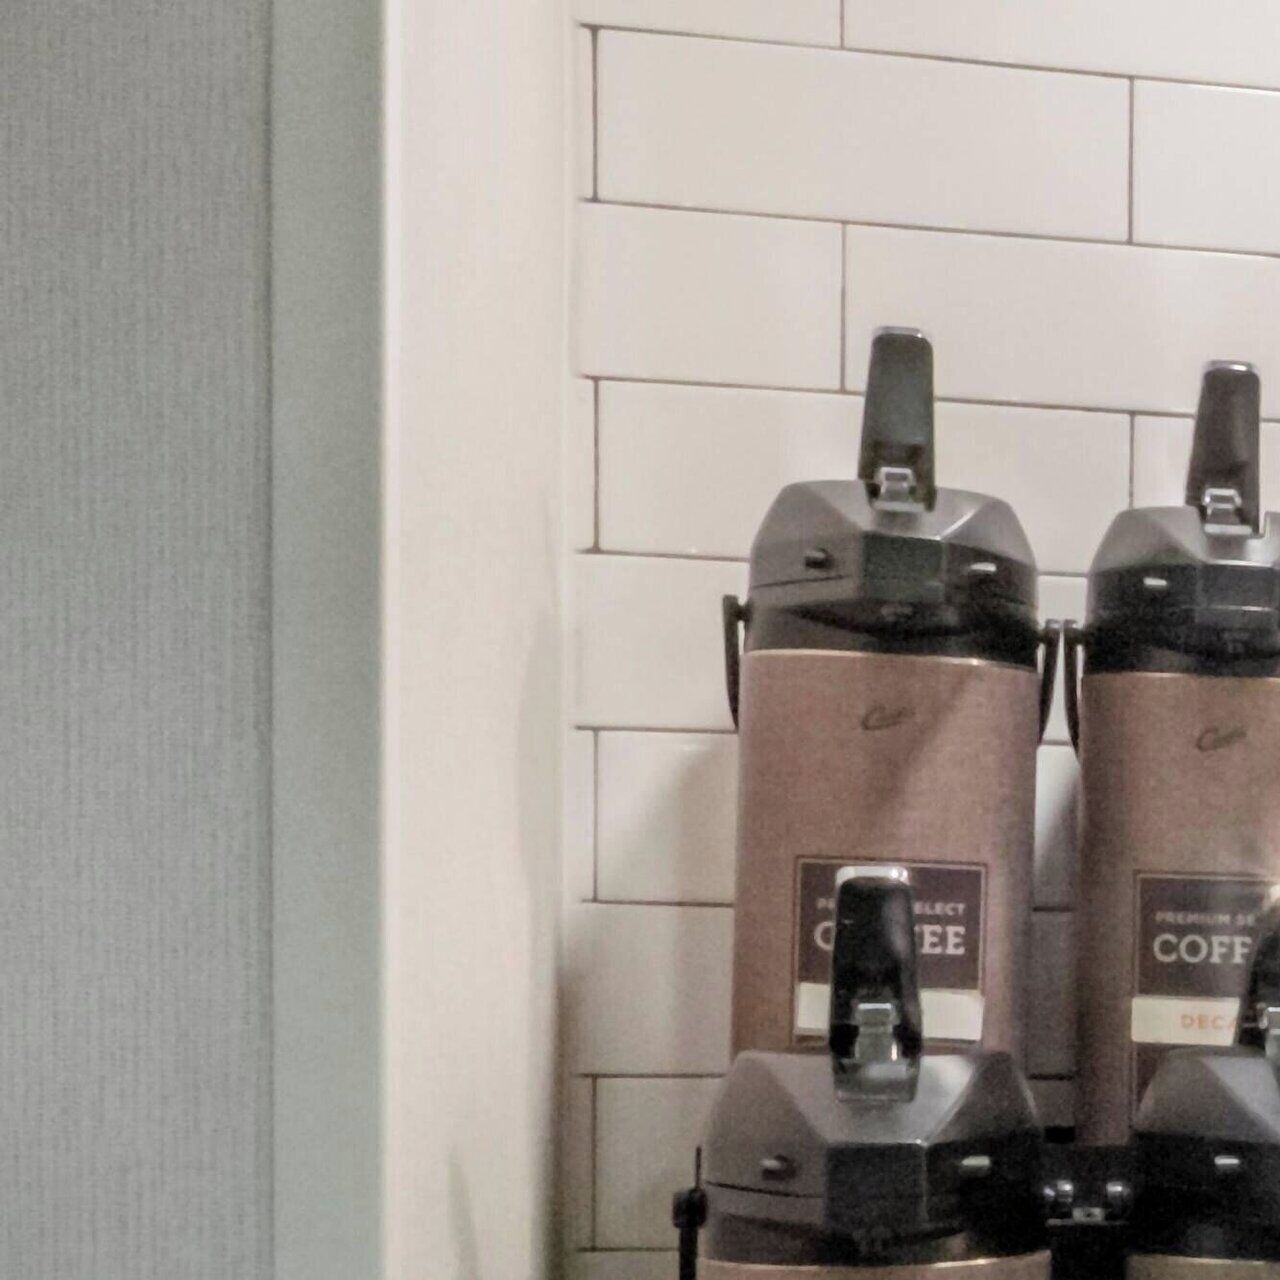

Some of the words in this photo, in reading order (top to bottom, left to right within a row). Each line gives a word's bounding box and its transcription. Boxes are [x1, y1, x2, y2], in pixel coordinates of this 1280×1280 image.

[914, 901, 966, 915] ELECT
[1155, 911, 1231, 924] PREMIUM
[1153, 933, 1253, 964] COFF
